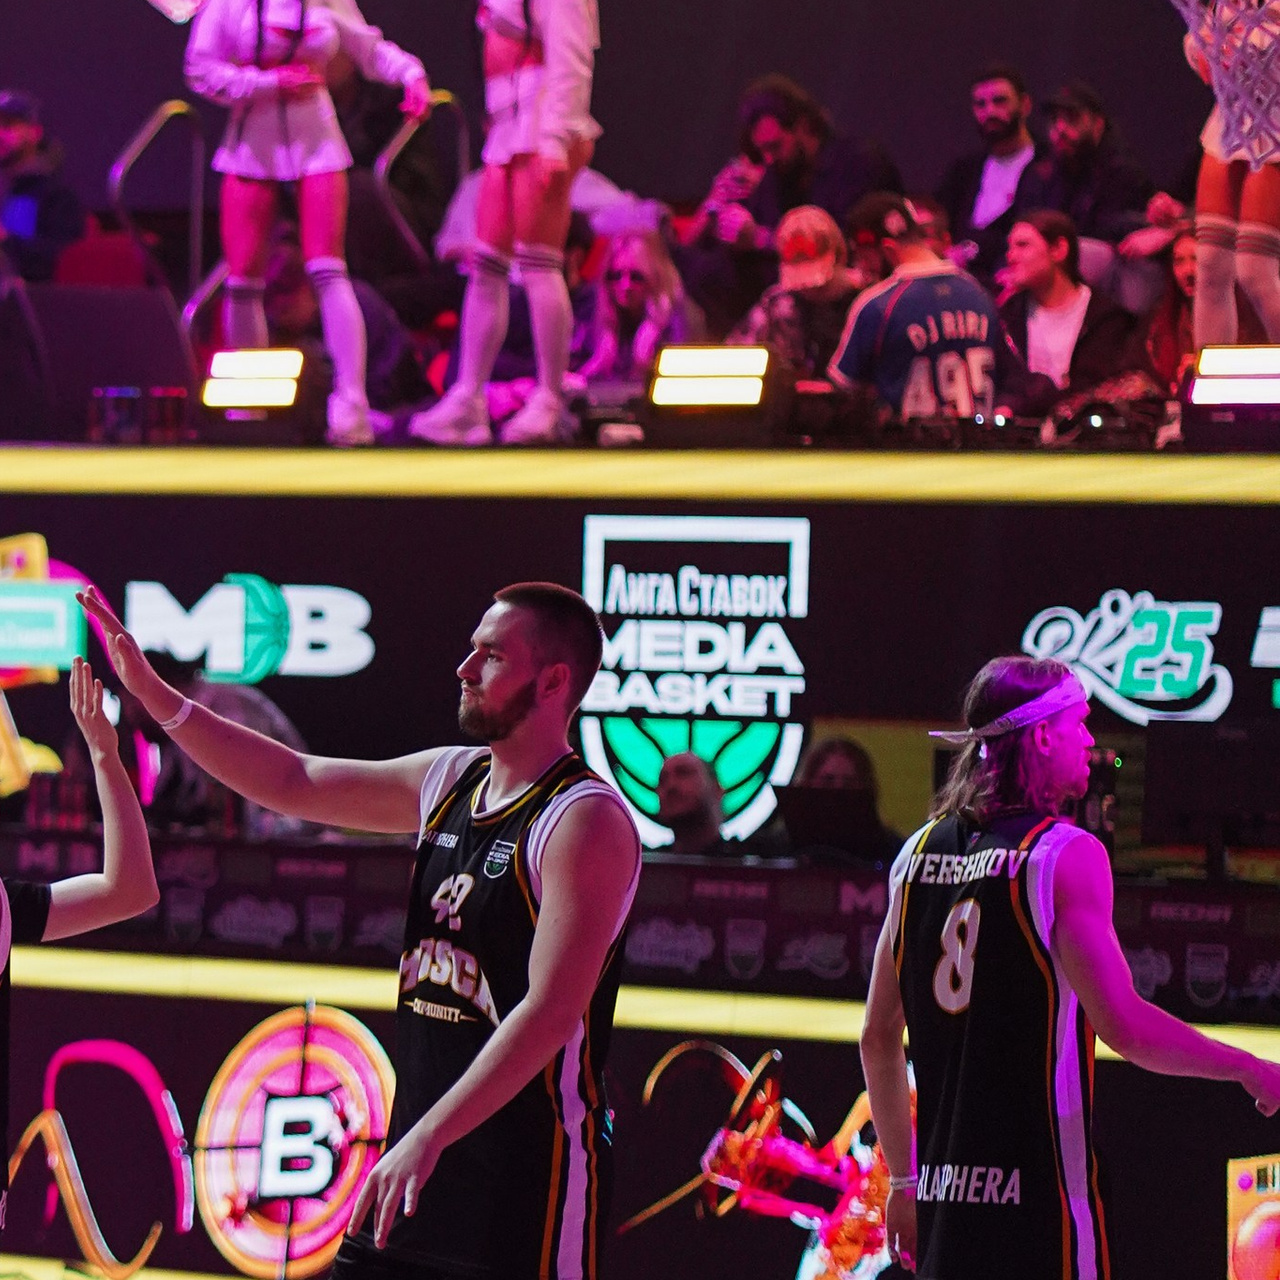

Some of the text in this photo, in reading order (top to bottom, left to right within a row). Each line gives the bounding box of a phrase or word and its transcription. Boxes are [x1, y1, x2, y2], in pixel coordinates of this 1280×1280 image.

[600, 619, 805, 674] MEDIA
[581, 670, 806, 718] BASKET
[907, 848, 1028, 884] VERSHKOV
[933, 897, 981, 1006] 8
[259, 1095, 337, 1198] B
